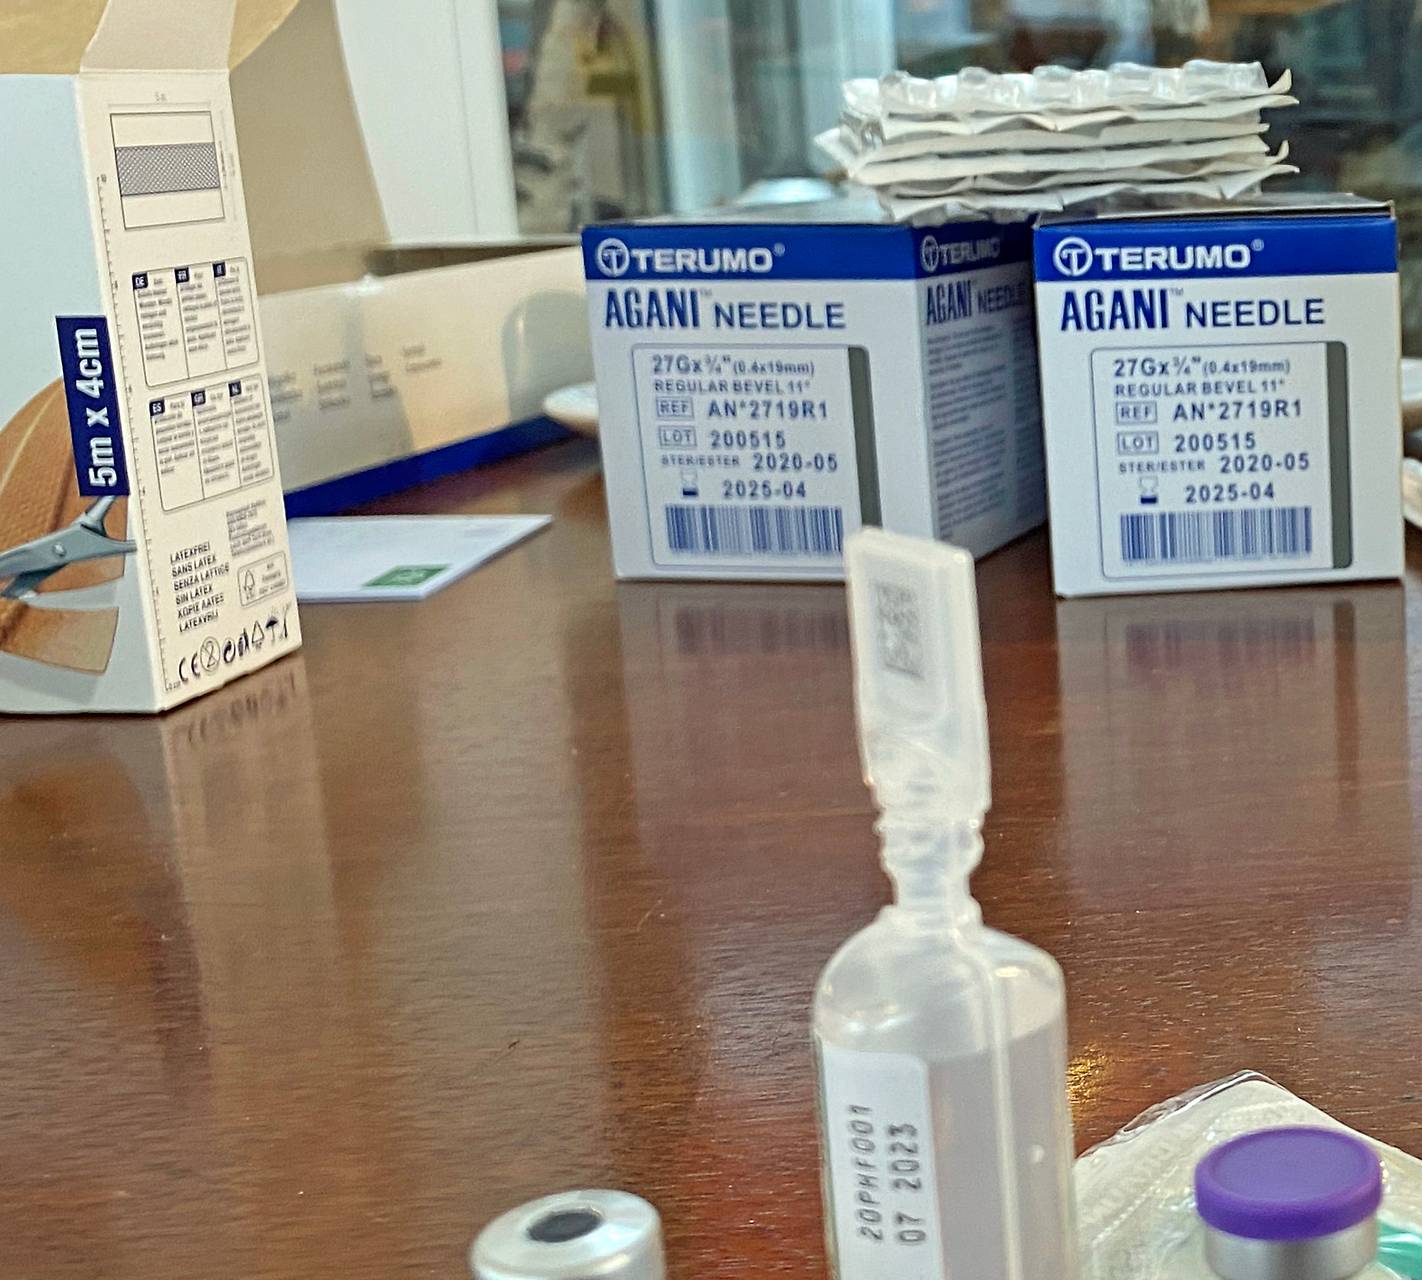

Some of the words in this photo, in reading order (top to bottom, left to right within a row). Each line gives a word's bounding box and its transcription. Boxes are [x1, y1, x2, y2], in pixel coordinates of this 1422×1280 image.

[714, 302, 847, 330] NEEDLE
[1186, 299, 1326, 329] NEEDLE
[75, 328, 105, 400] 4cm
[655, 379, 729, 394] REGULAR
[733, 379, 783, 394] BEVEL
[1115, 382, 1197, 398] REGULAR
[1202, 380, 1256, 395] BEVEL
[86, 406, 110, 428] x
[660, 401, 690, 414] REF
[1120, 406, 1151, 419] REF
[662, 430, 693, 443] LOT
[710, 430, 787, 449] 200515
[1121, 436, 1153, 450] LOT
[1175, 432, 1257, 452] 200515
[88, 436, 118, 488] 5m
[752, 453, 838, 472] 2020-05
[1219, 453, 1310, 474] 2020-05
[723, 480, 807, 499] 2025-04
[1185, 482, 1275, 504] 2025-04
[171, 563, 193, 578] SANS
[173, 577, 200, 592] SENZA
[175, 593, 189, 606] SIN
[888, 1122, 923, 1191] 2023
[896, 1211, 926, 1244] 07
